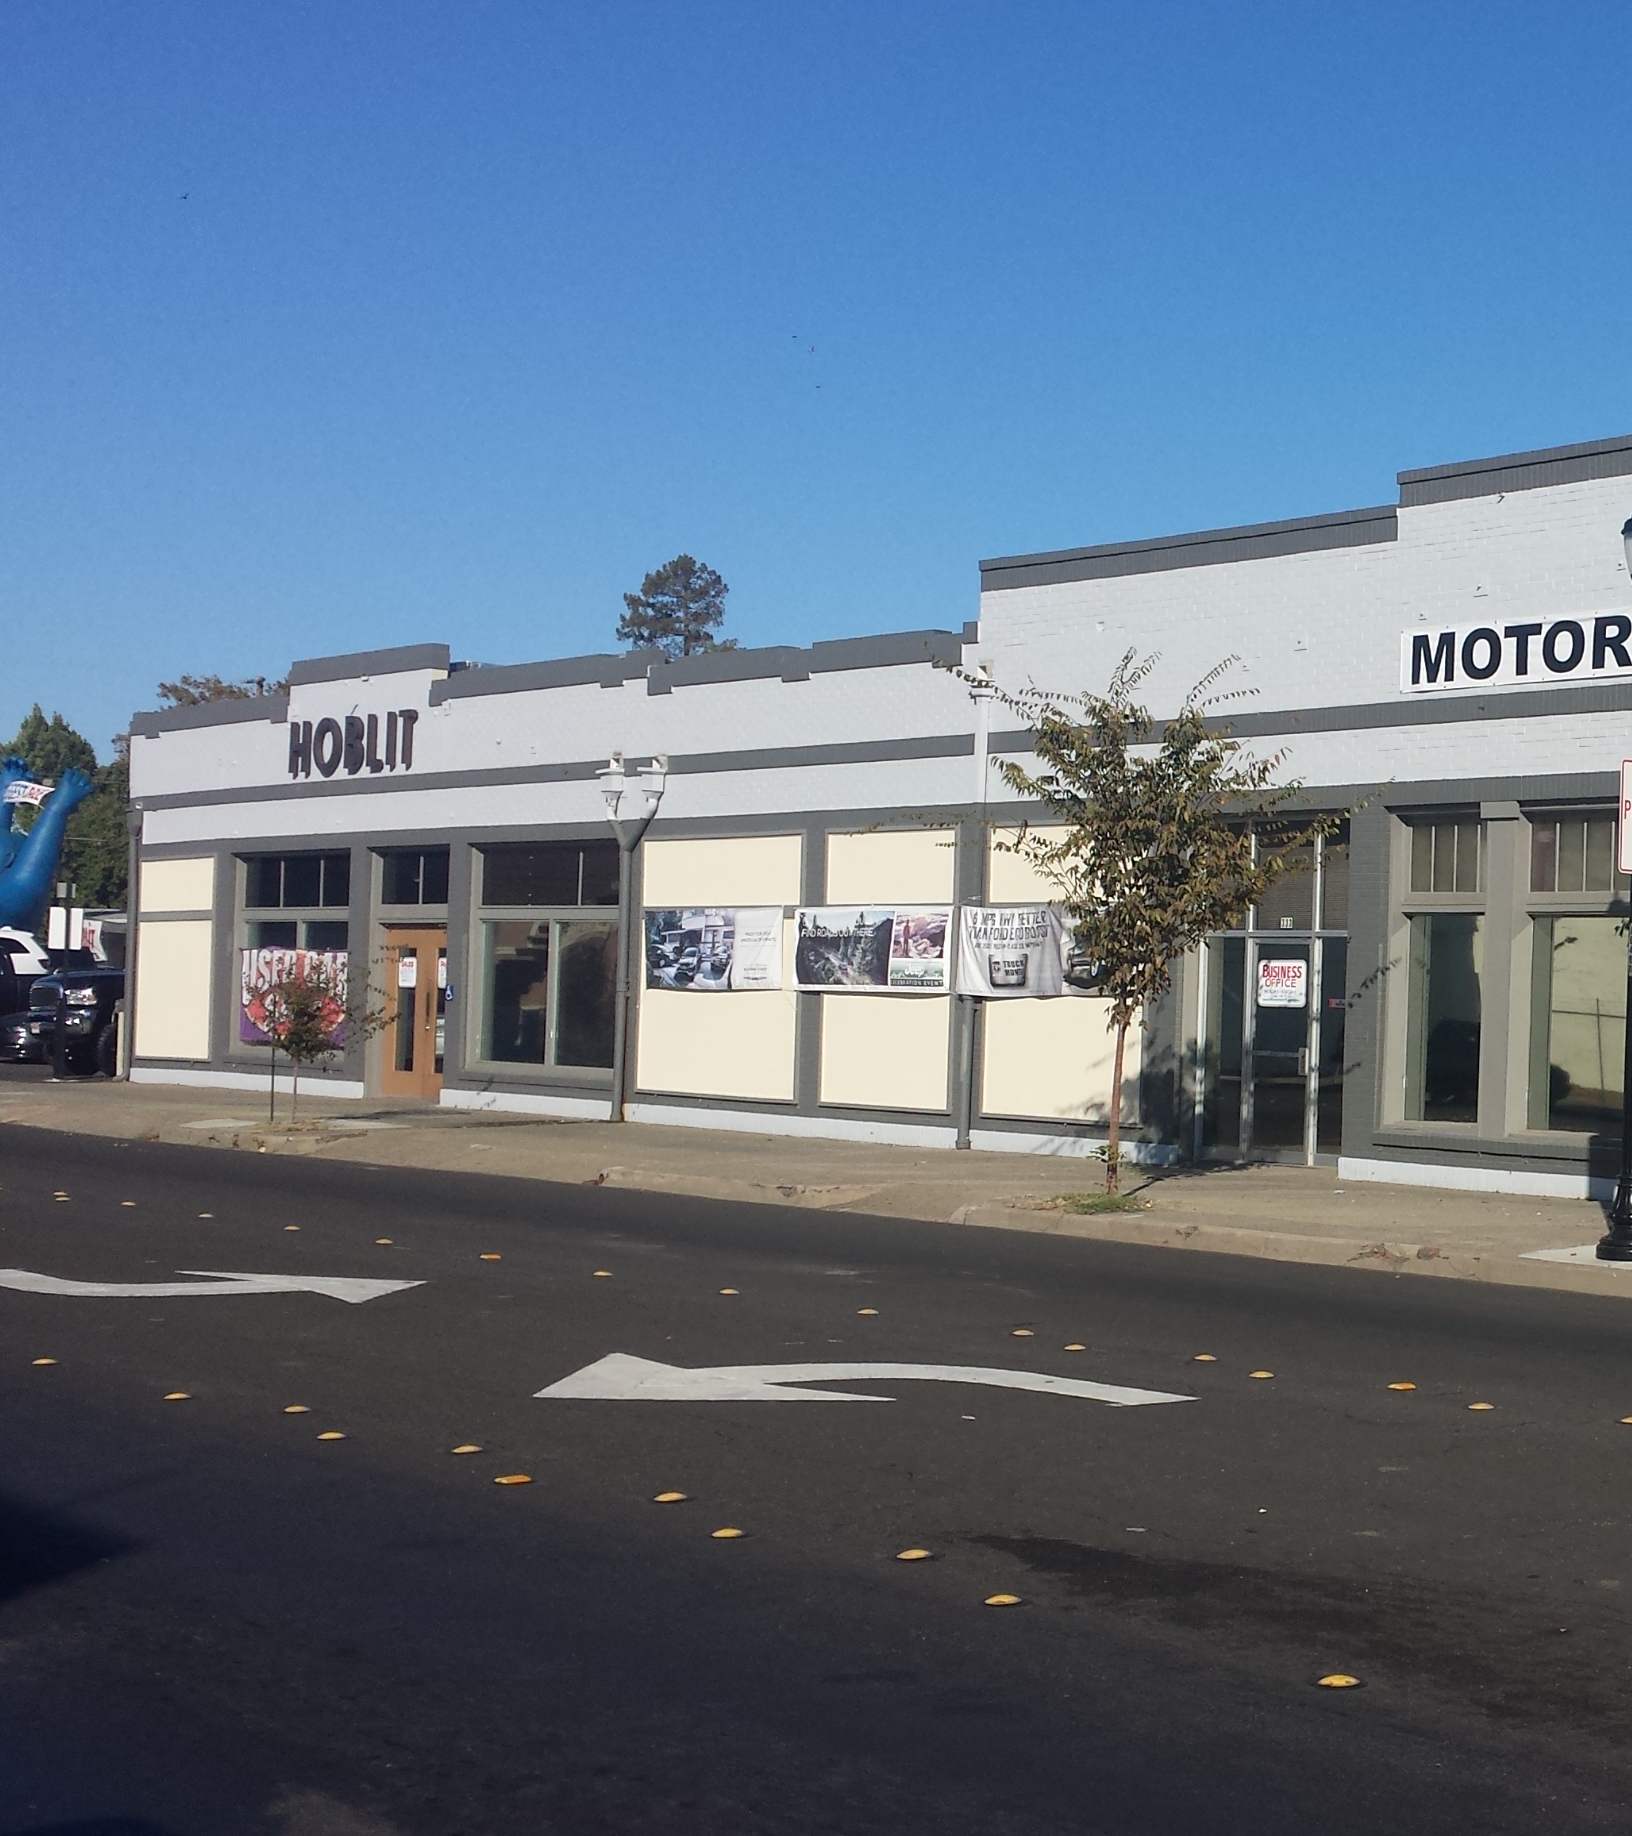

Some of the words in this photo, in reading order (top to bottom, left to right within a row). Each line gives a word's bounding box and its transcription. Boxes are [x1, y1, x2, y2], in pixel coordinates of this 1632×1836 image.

[288, 708, 418, 780] HOBLIT
[242, 949, 297, 1005] USED
[905, 964, 924, 977] Jeep
[1262, 964, 1303, 979] BUSINESS
[1265, 979, 1297, 988] OFFICE
